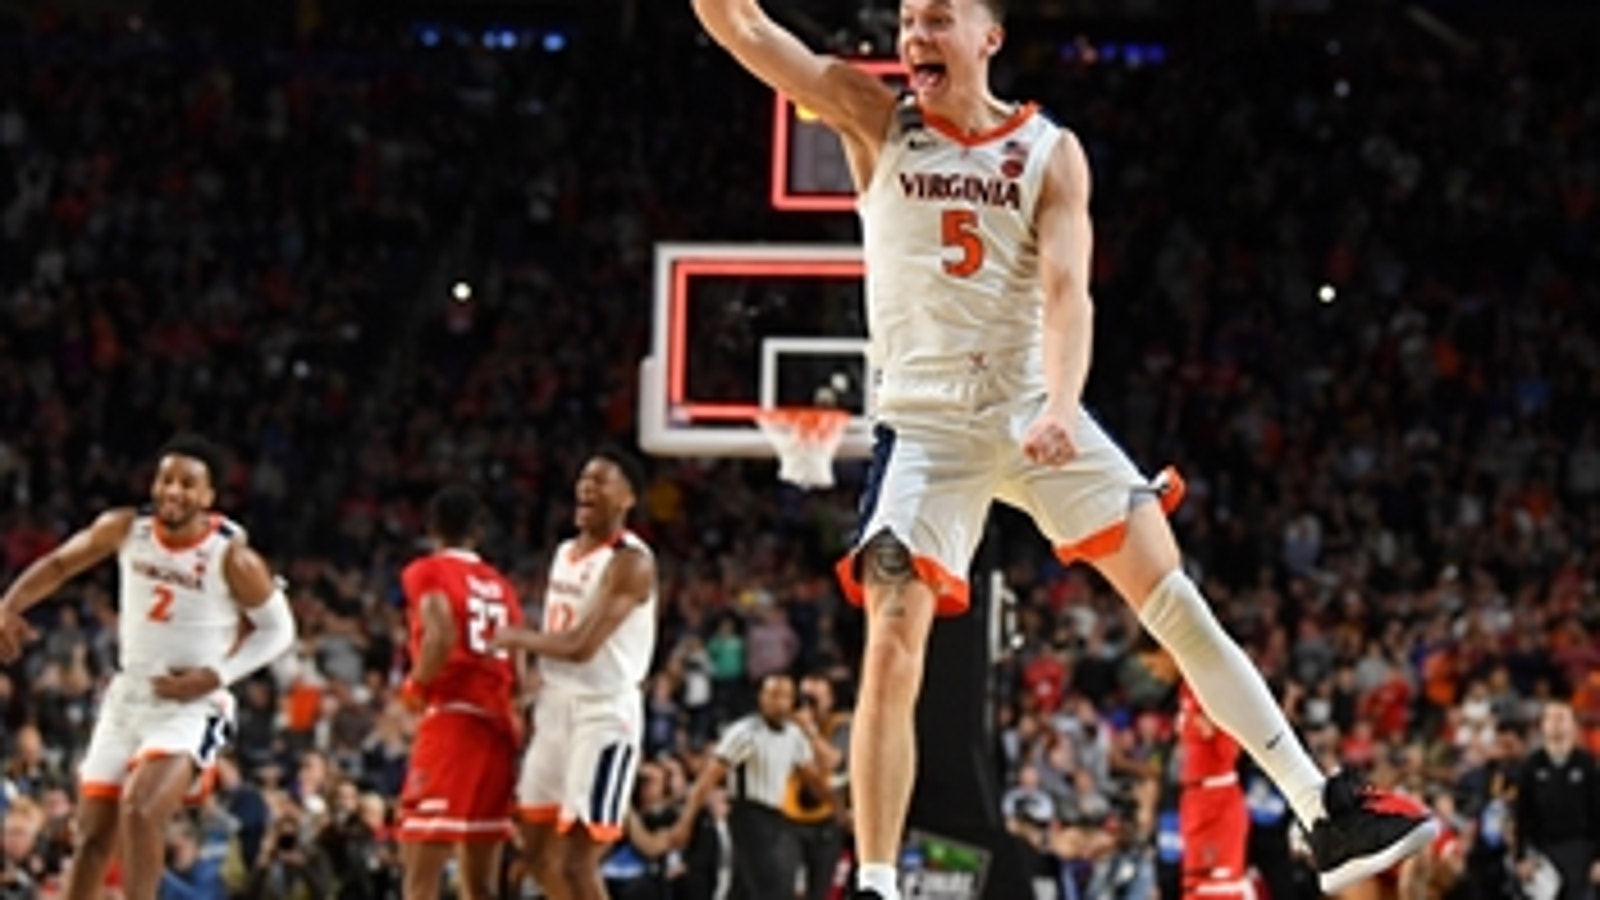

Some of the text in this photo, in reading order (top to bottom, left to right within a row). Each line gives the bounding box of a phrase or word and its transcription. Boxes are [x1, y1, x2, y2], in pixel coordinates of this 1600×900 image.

[899, 173, 1020, 210] VIRGINIA
[941, 210, 984, 277] 5
[148, 585, 174, 622] 2
